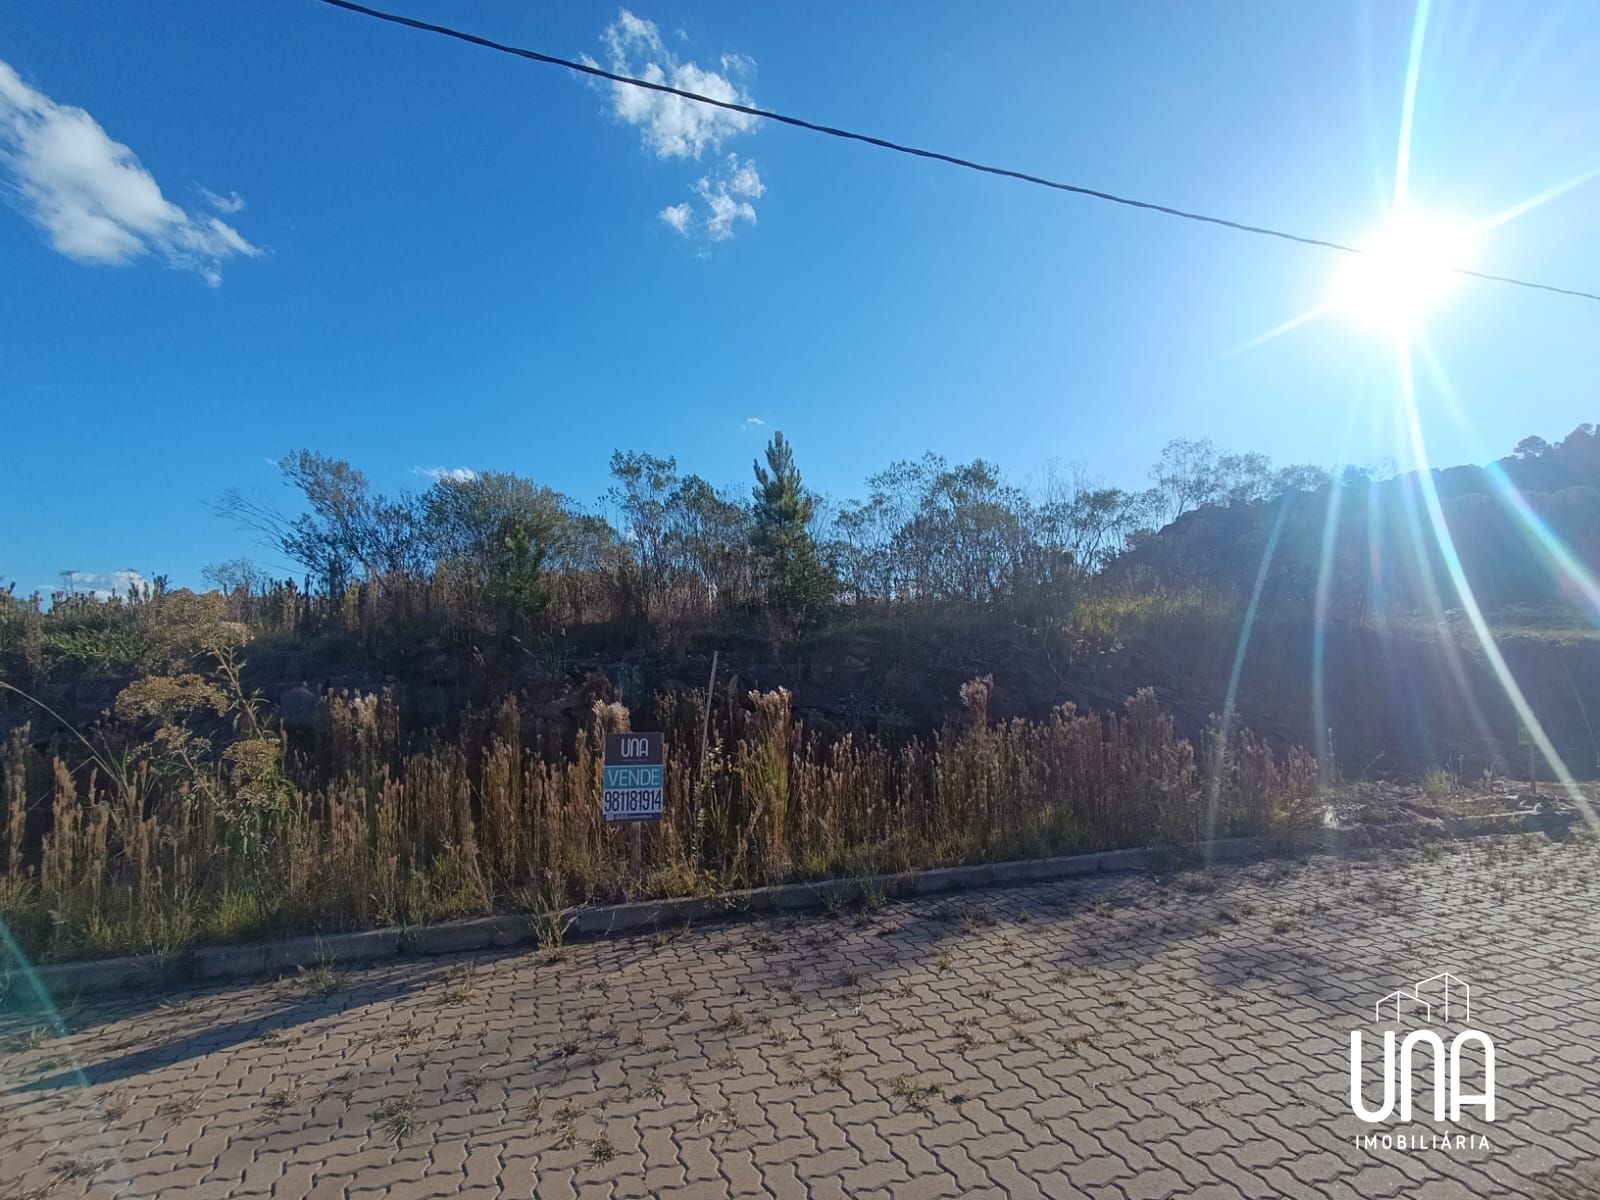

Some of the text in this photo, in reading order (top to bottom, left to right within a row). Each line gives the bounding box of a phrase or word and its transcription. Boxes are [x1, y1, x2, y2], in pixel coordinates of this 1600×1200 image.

[621, 738, 649, 757] UNA
[608, 768, 660, 786] VENDE
[605, 790, 662, 812] 981181914
